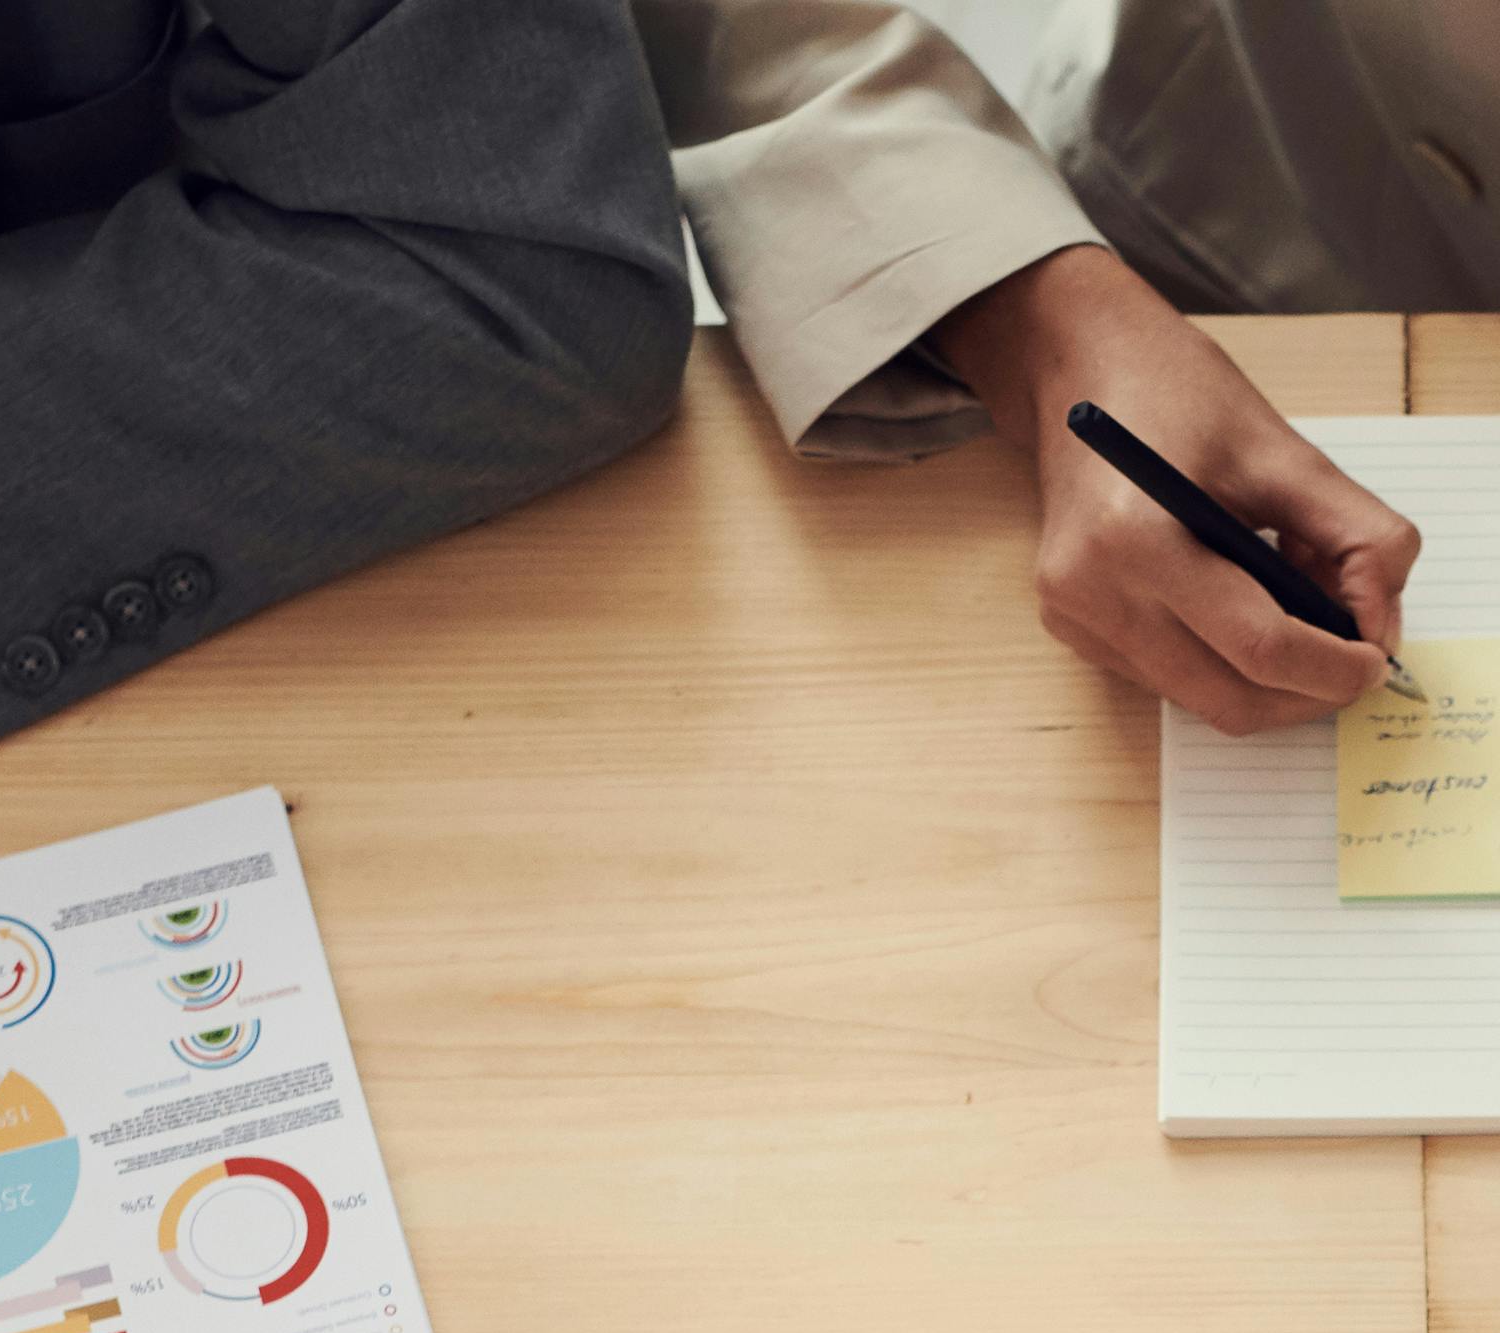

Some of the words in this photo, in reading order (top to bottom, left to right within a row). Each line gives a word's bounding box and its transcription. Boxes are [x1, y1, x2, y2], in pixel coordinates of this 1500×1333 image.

[120, 1195, 154, 1213] 25%
[331, 1192, 368, 1211] 50%
[130, 1277, 165, 1297] 15%
